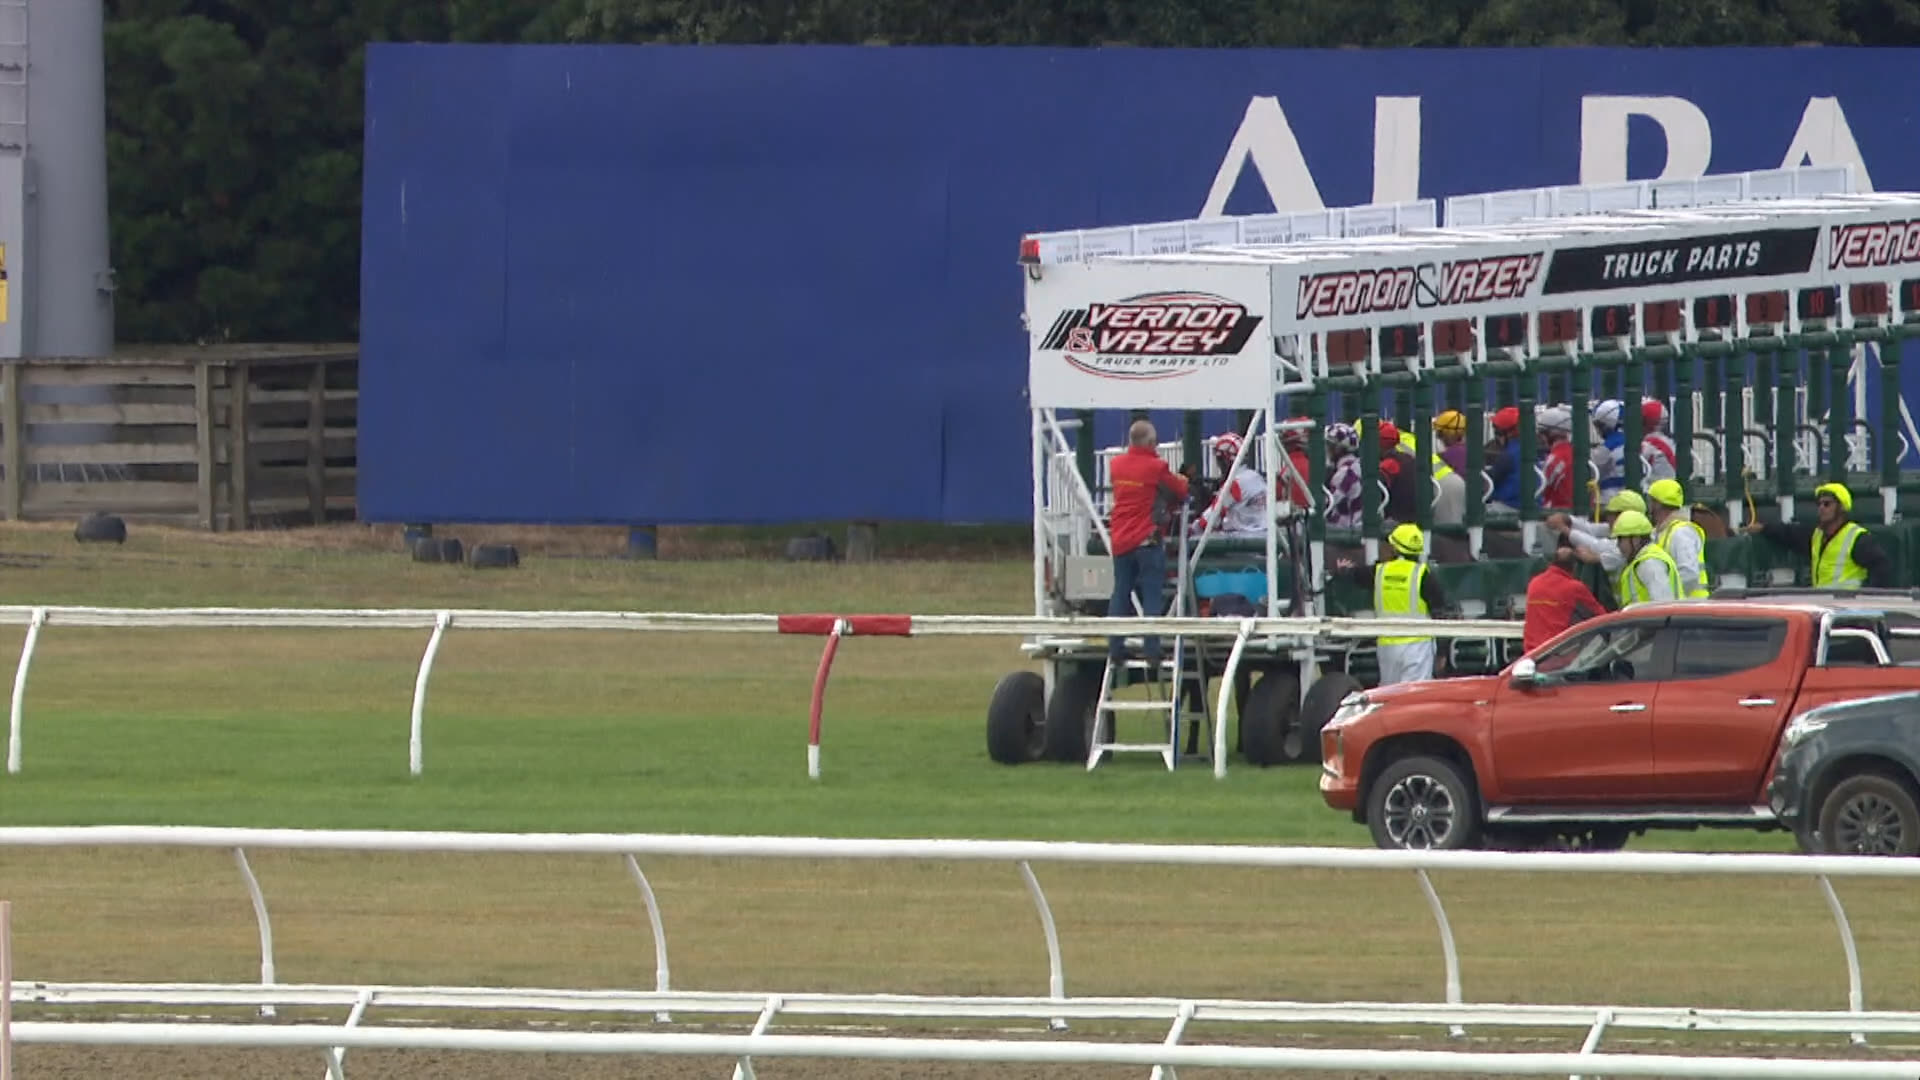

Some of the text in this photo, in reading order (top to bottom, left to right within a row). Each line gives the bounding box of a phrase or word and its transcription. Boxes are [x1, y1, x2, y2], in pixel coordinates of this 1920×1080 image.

[1602, 240, 1762, 279] TRUCK PARTS
[1297, 266, 1414, 318] VERNON
[1436, 252, 1543, 303] VAZEY
[1089, 303, 1244, 329] VERNON
[1098, 329, 1232, 353] VAZEY
[1095, 356, 1230, 367] TRUCK PARTS LTD
